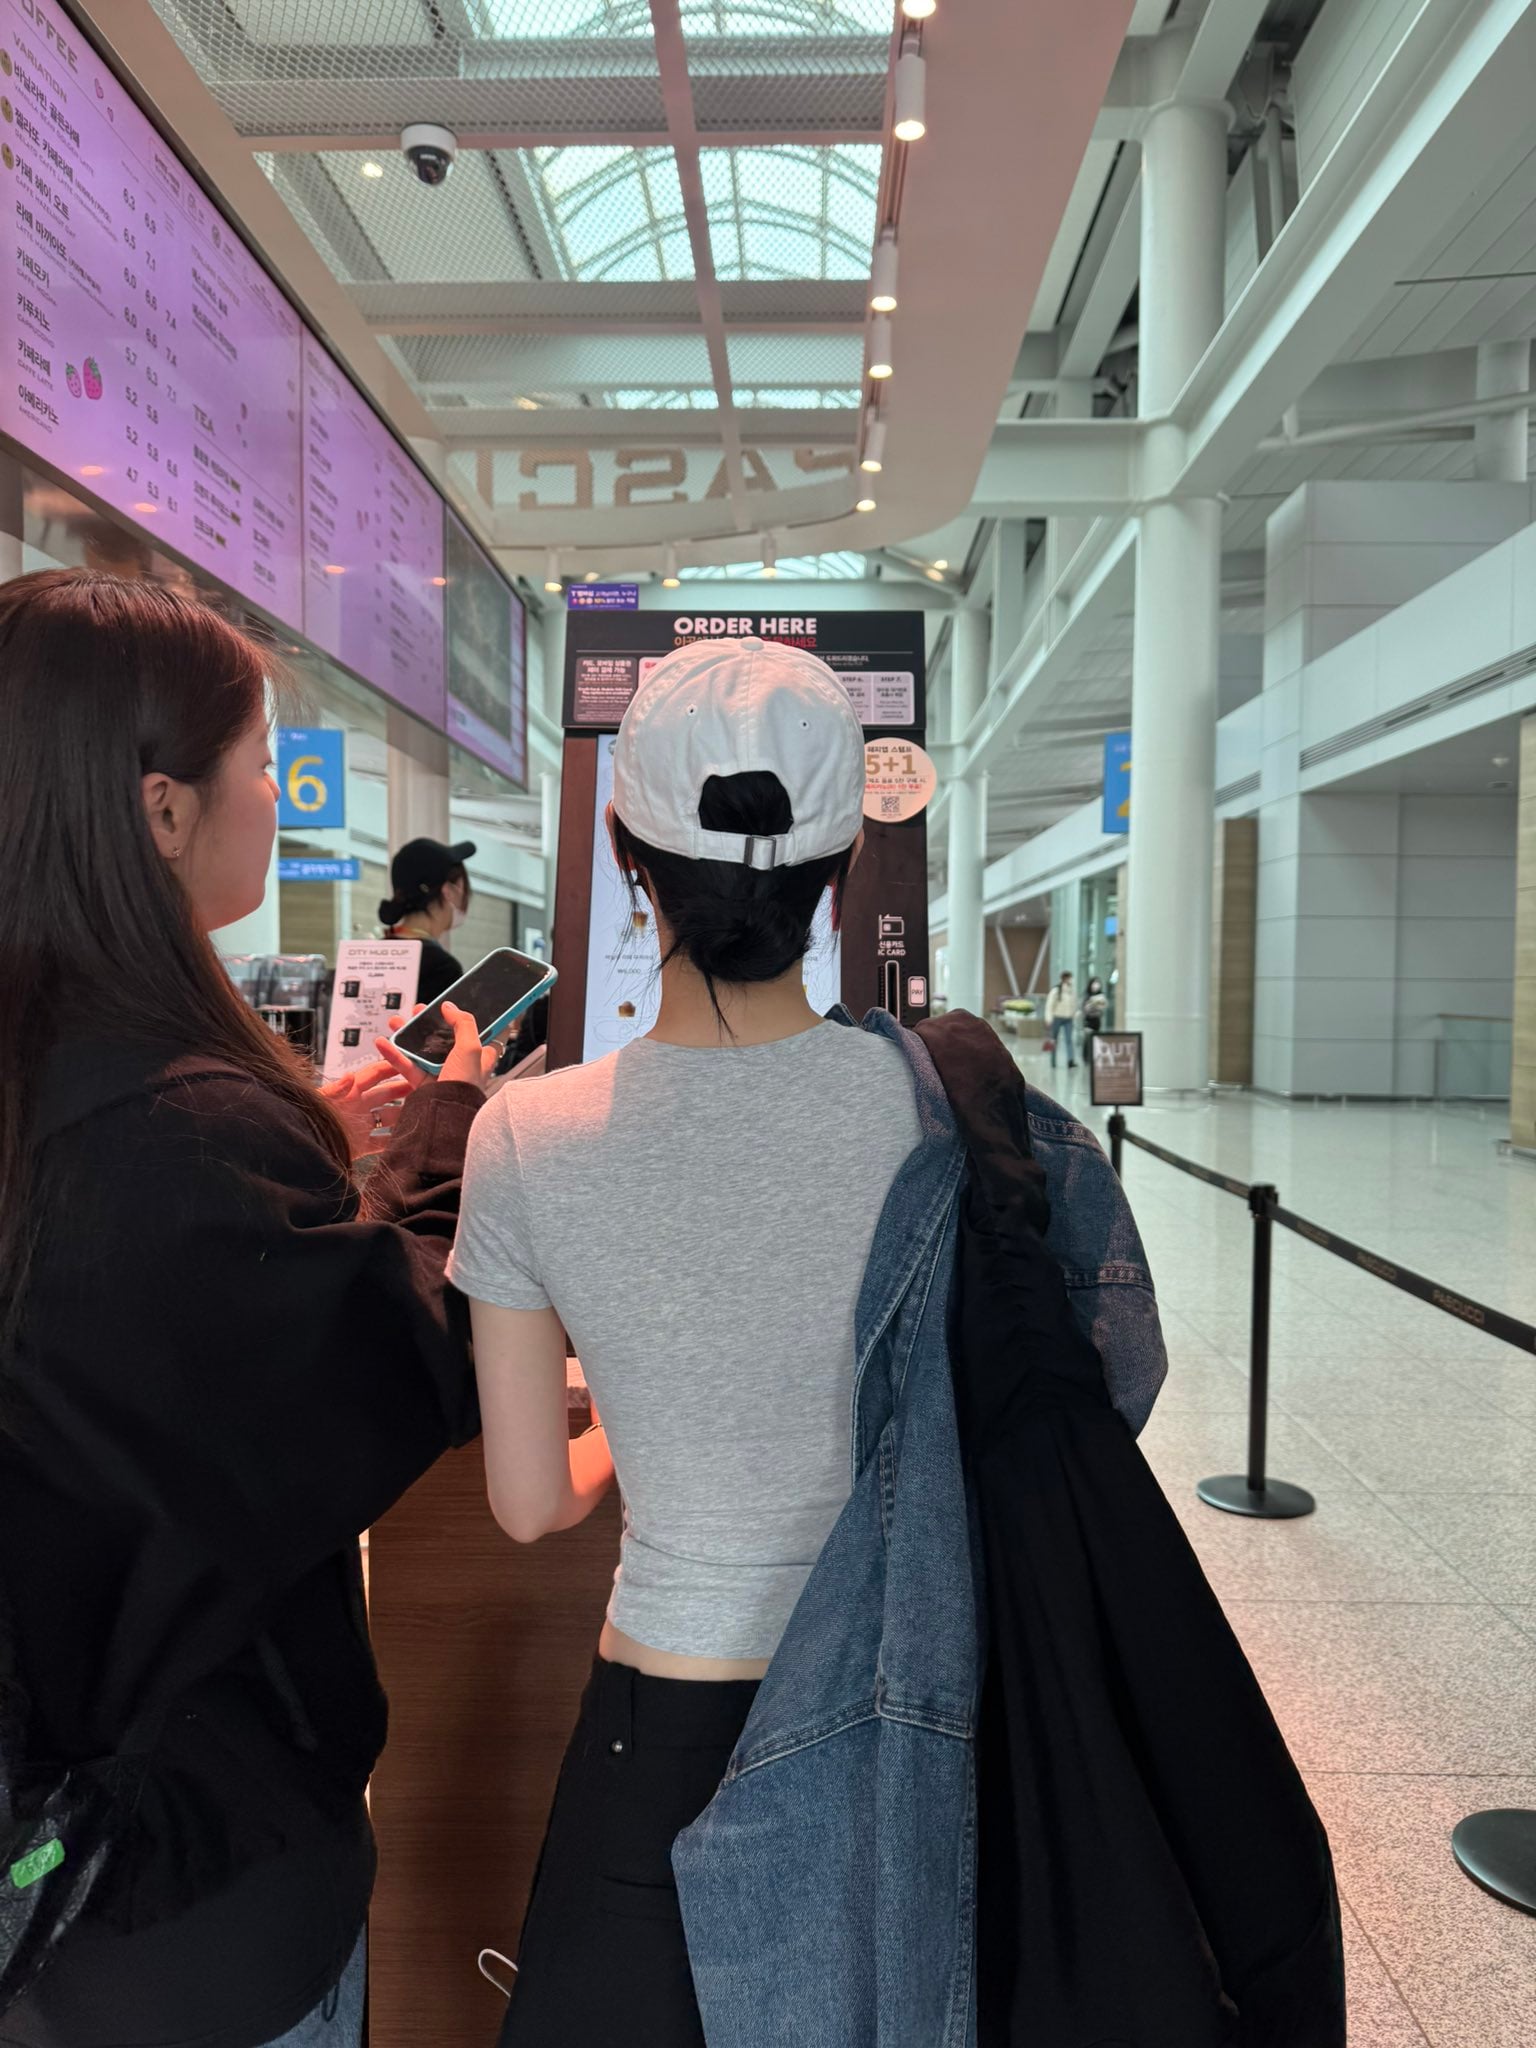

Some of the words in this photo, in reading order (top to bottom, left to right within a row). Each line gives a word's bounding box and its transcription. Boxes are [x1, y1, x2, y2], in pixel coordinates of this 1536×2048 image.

[14, 32, 67, 103] VARIATION
[43, 140, 73, 182] 카페라떼
[16, 155, 32, 183] 카페
[54, 195, 69, 220] 오트
[16, 200, 33, 229] 라떼
[36, 221, 67, 261] 마끼아또
[17, 248, 49, 288] 카페모카
[18, 293, 50, 331] 카푸치노
[18, 339, 50, 376] 카페라떼
[19, 385, 58, 425] 아메리카노
[126, 386, 137, 407] 5.2
[126, 426, 138, 445] 5.2
[194, 405, 216, 436] TEA
[674, 617, 754, 634] ORDER
[760, 617, 817, 634] HERE
[287, 755, 328, 812] 6
[866, 754, 916, 775] 5+1
